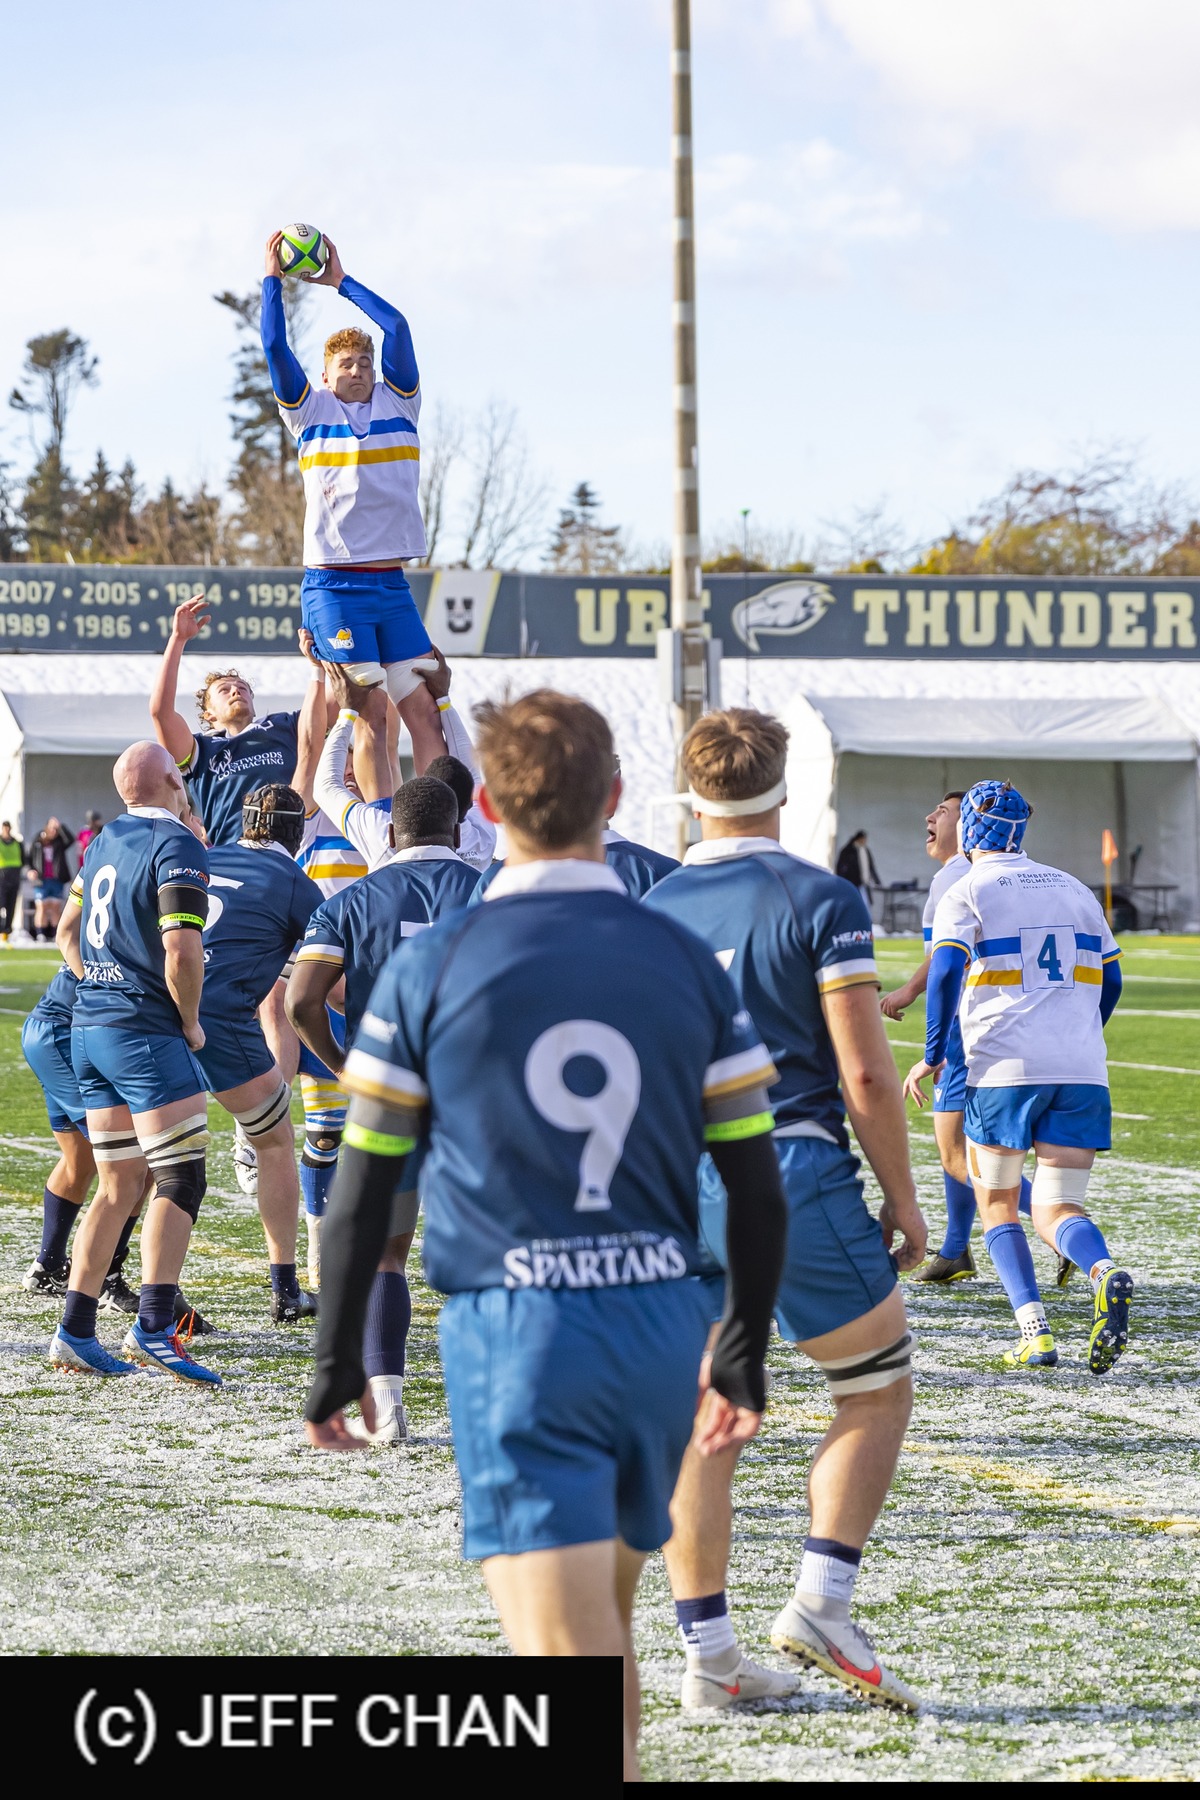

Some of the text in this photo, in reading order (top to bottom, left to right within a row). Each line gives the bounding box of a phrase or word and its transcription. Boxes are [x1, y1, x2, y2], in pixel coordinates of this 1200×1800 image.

[0, 580, 56, 604] 2007
[80, 582, 141, 606] 2005
[247, 583, 301, 608] 1992
[575, 588, 1197, 648] UB THUNDER
[0, 613, 50, 638] 1989
[73, 614, 132, 639] 1986
[235, 616, 294, 640] 1984
[218, 758, 284, 780] CONTRACTING
[86, 864, 117, 949] 8
[1037, 934, 1064, 981] 4
[524, 1018, 642, 1212] 9
[503, 1234, 687, 1289] SPARTANS
